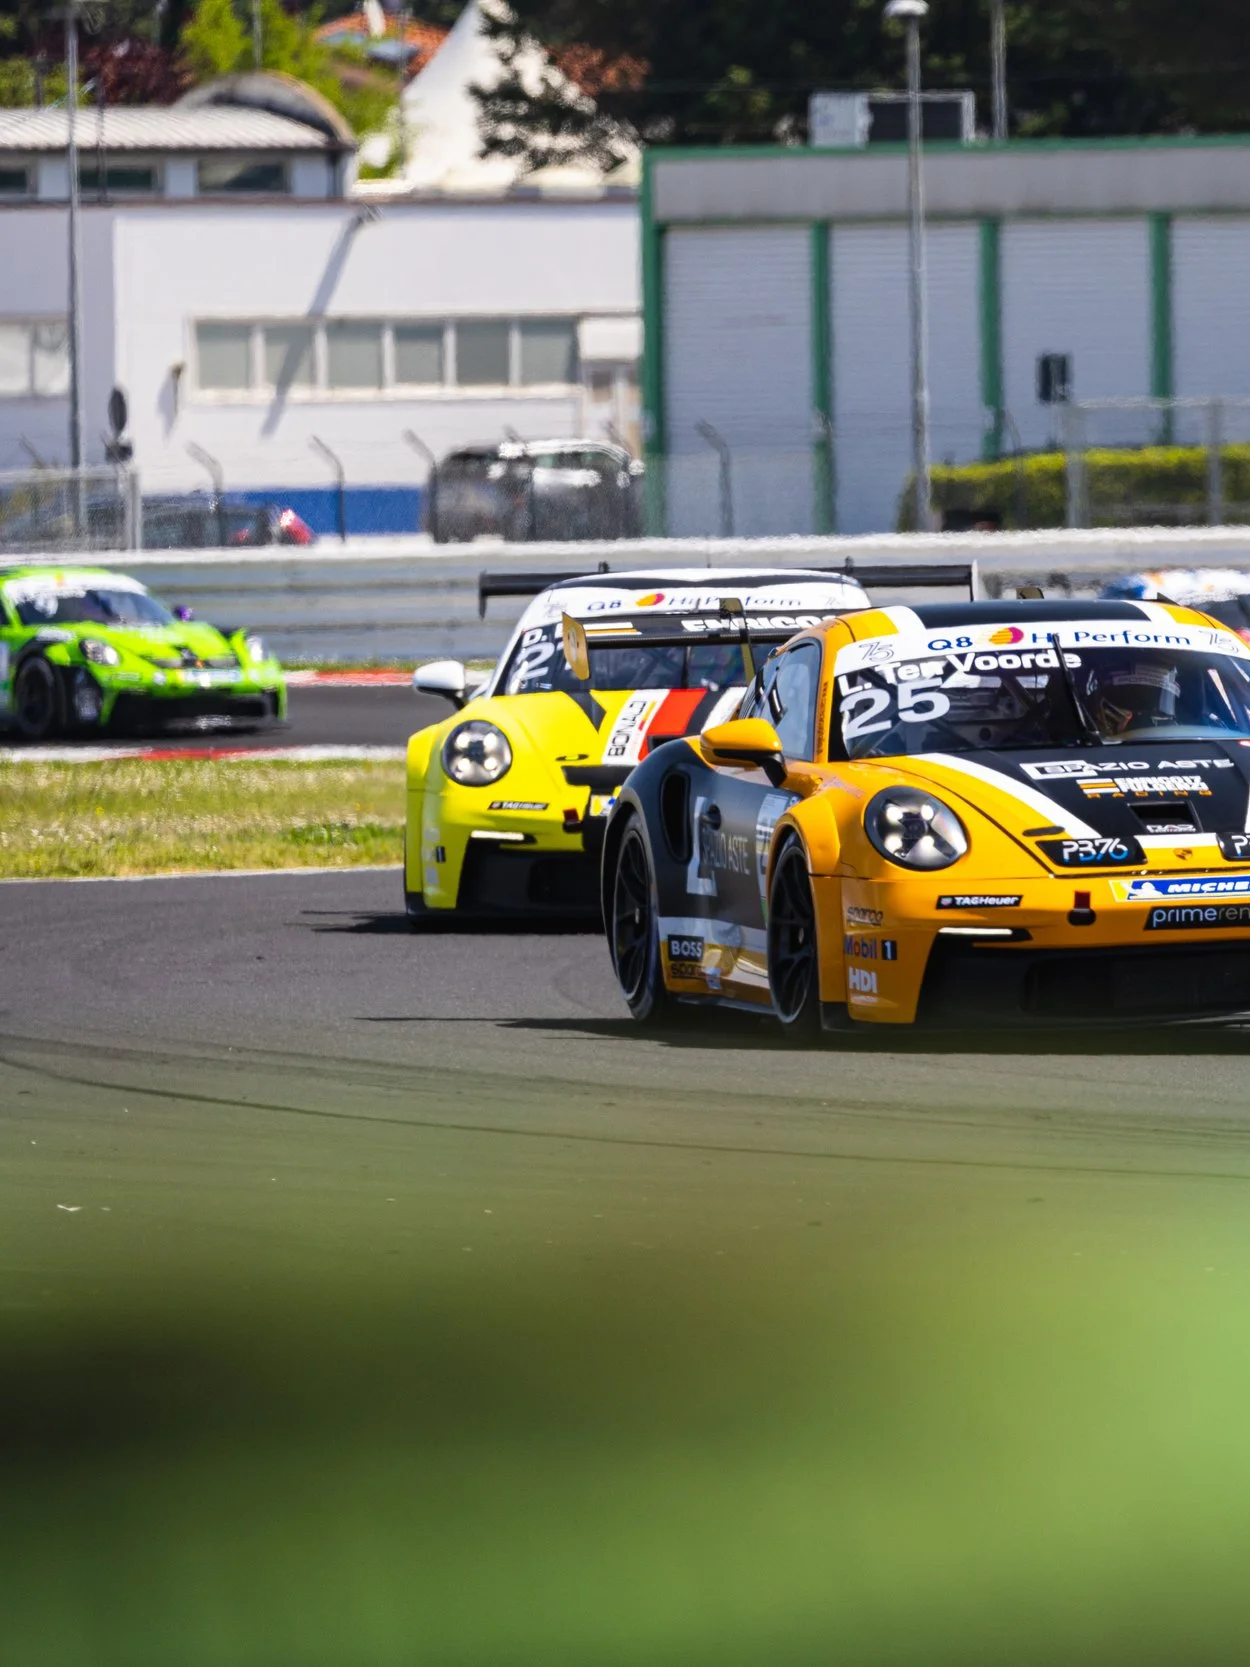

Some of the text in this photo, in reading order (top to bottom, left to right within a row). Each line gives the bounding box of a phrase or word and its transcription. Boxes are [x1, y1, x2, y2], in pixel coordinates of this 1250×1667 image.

[587, 600, 622, 611] Q8
[704, 595, 802, 607] Pform
[927, 636, 973, 651] Q8
[1074, 628, 1192, 647] Perform
[838, 675, 873, 698] L.
[946, 649, 1082, 673] Voorde
[839, 677, 950, 741] 25
[1043, 758, 1236, 775] SPAZIO ASTE
[671, 940, 703, 958] BOSS
[844, 935, 878, 960] Mobil
[849, 966, 878, 993] HDI
